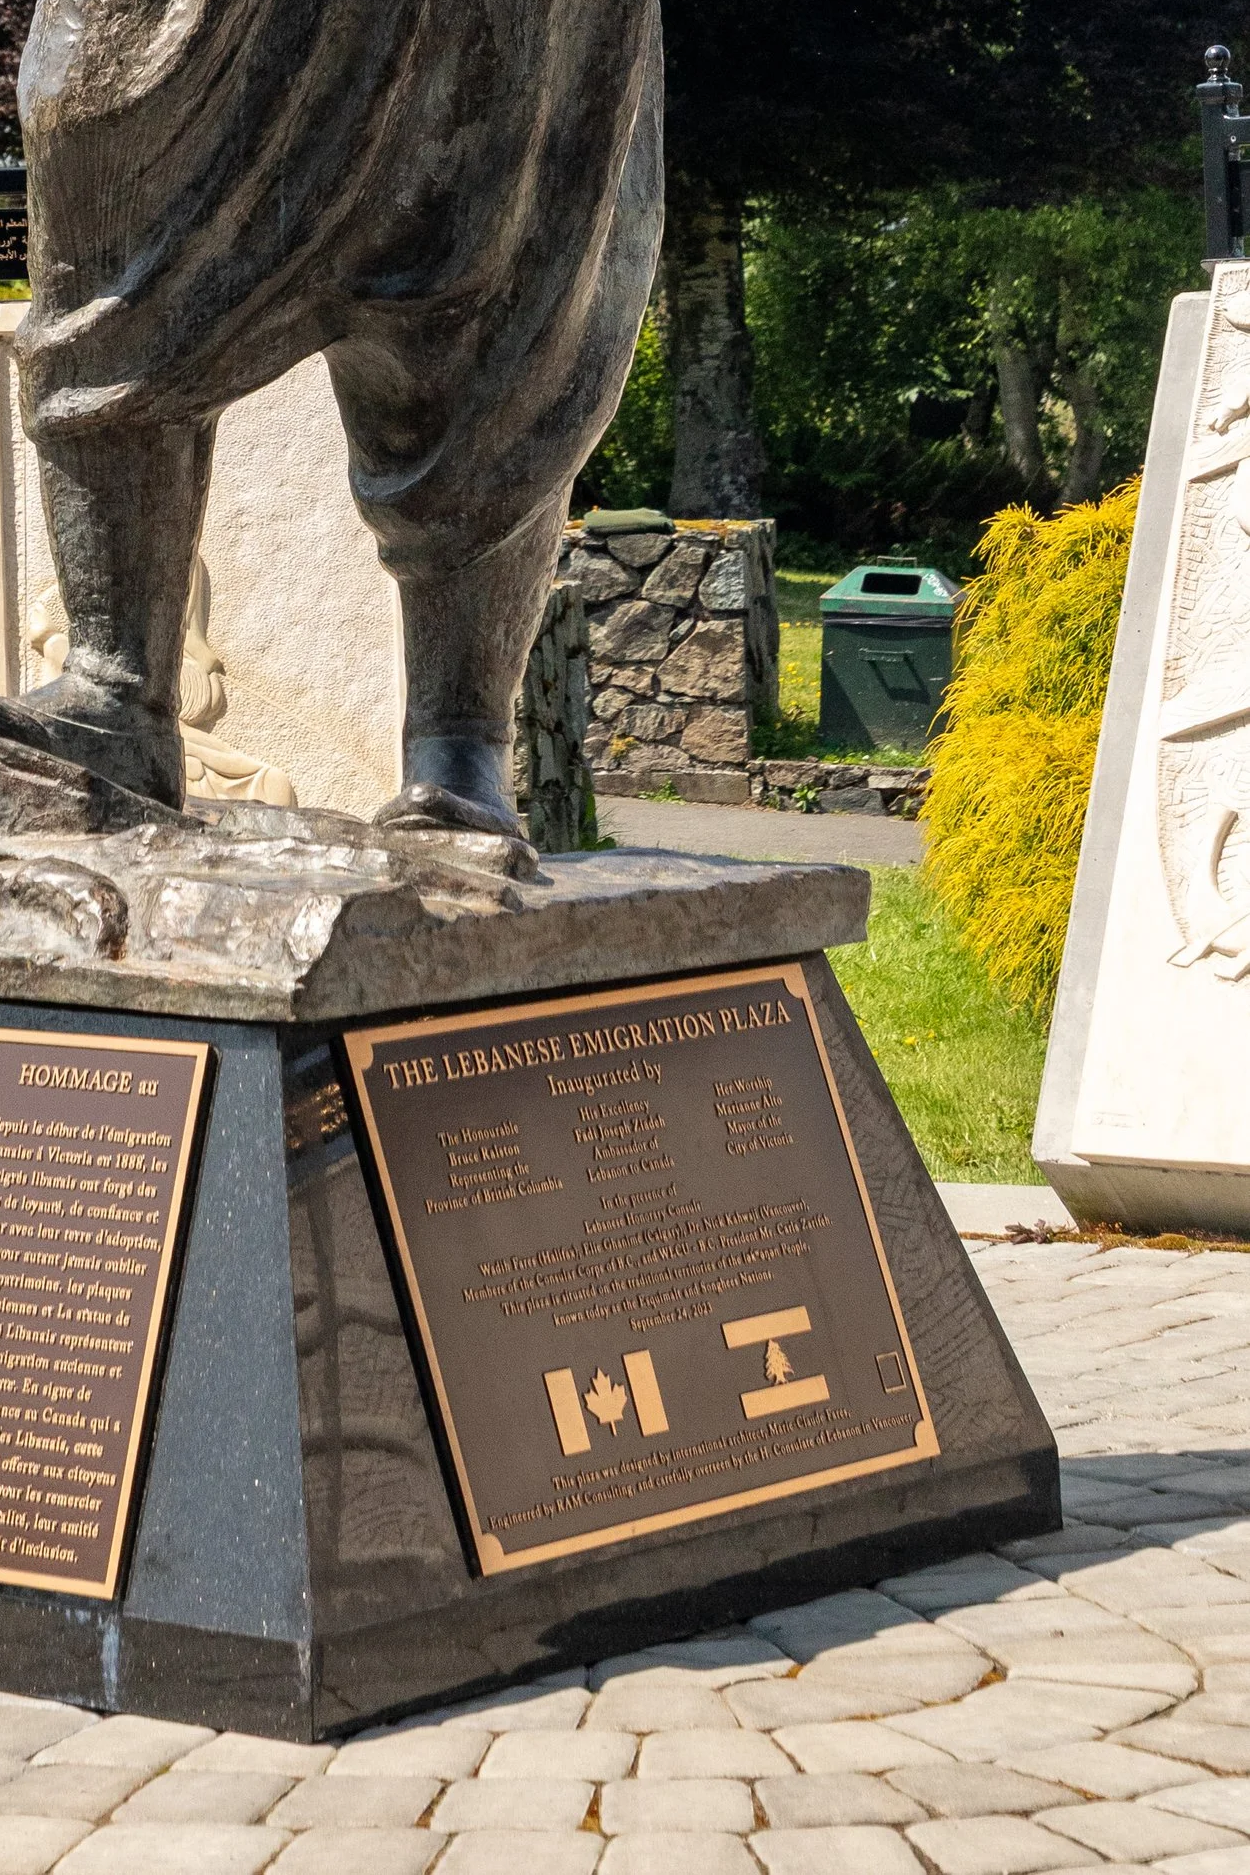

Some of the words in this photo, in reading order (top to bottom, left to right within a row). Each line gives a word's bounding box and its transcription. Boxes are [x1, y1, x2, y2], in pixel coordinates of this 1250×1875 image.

[383, 1057, 438, 1088] THE
[442, 1036, 565, 1079] LEBANESE
[568, 1011, 715, 1057] EMIGRATION
[718, 999, 791, 1032] PLAZA
[18, 1063, 132, 1093] HOMMAGE
[137, 1079, 159, 1095] au
[547, 1060, 640, 1096] Inaugurated
[642, 1058, 661, 1084] by
